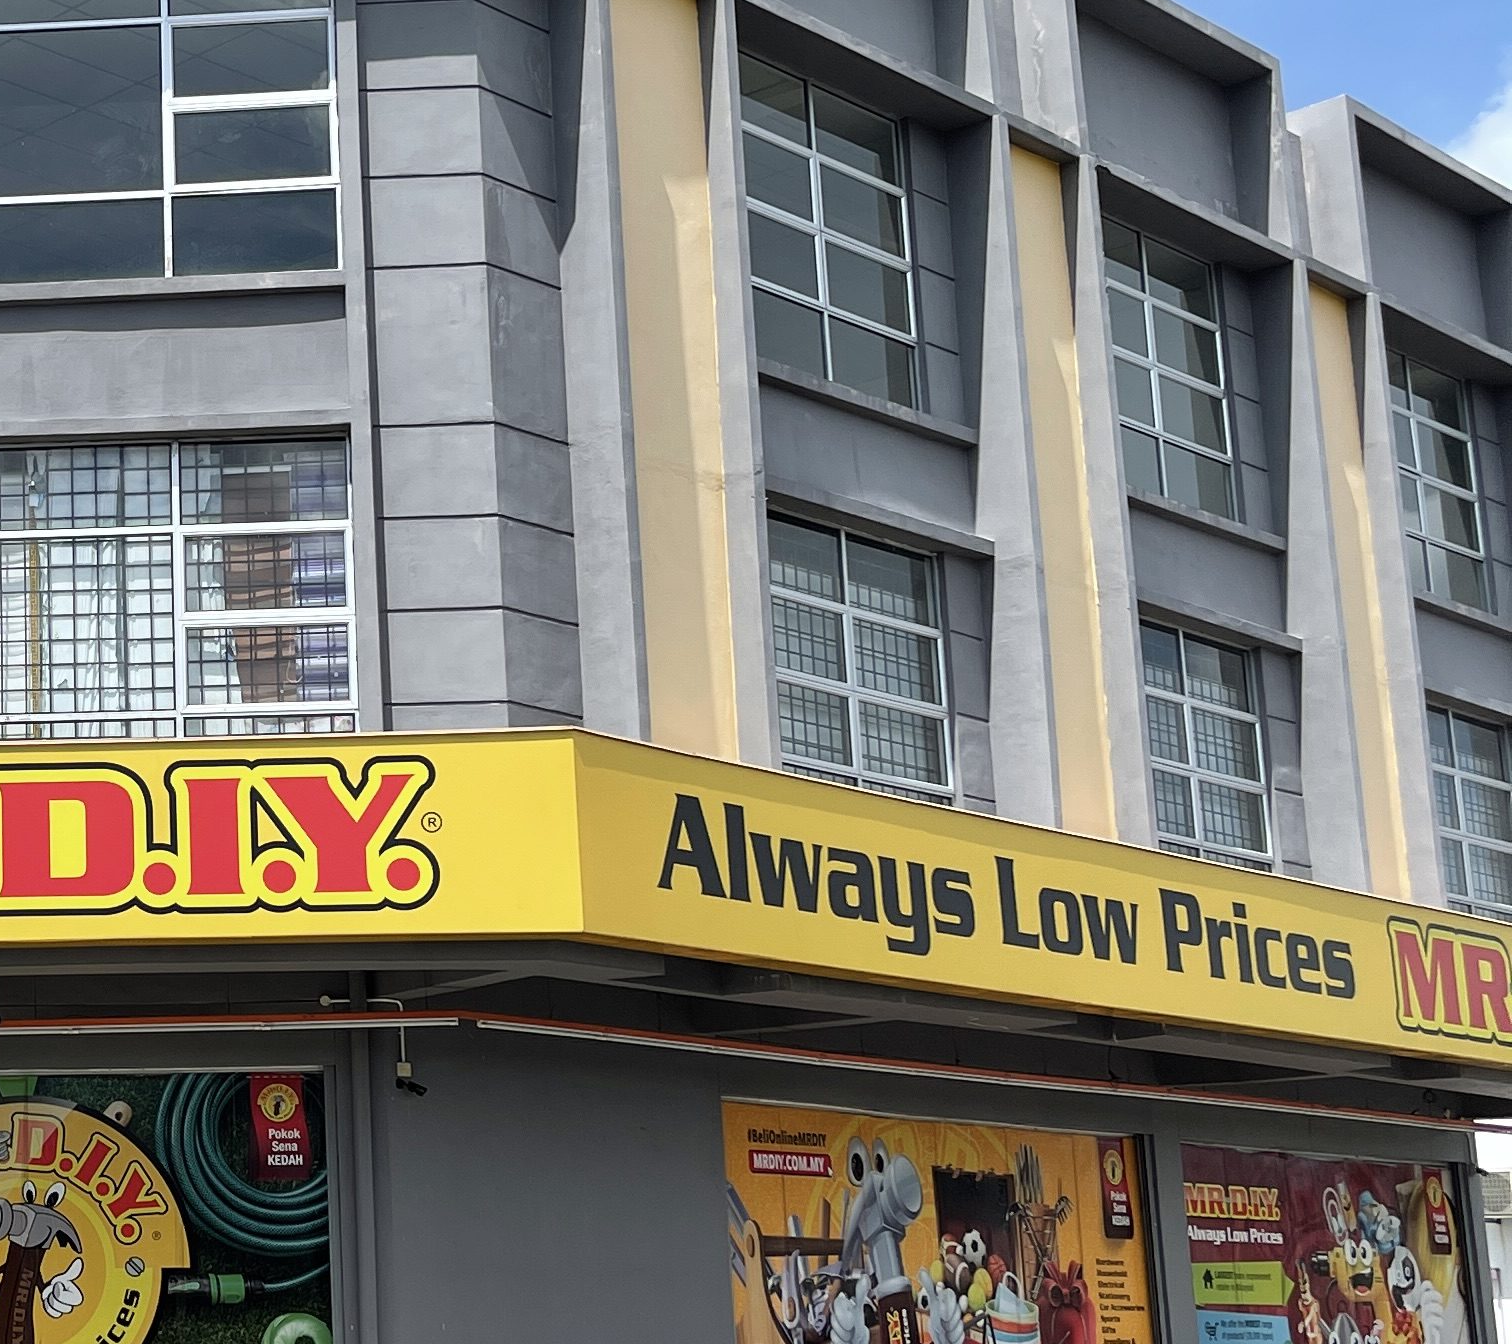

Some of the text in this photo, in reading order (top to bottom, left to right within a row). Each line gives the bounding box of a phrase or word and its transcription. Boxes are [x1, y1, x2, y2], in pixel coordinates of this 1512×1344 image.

[657, 793, 1356, 1001] Always Low Prices
[268, 1128, 301, 1140] Pokok
[271, 1141, 298, 1152] Sena
[267, 1154, 304, 1166] KEDAH
[1187, 1223, 1284, 1245] Always Low Prices
